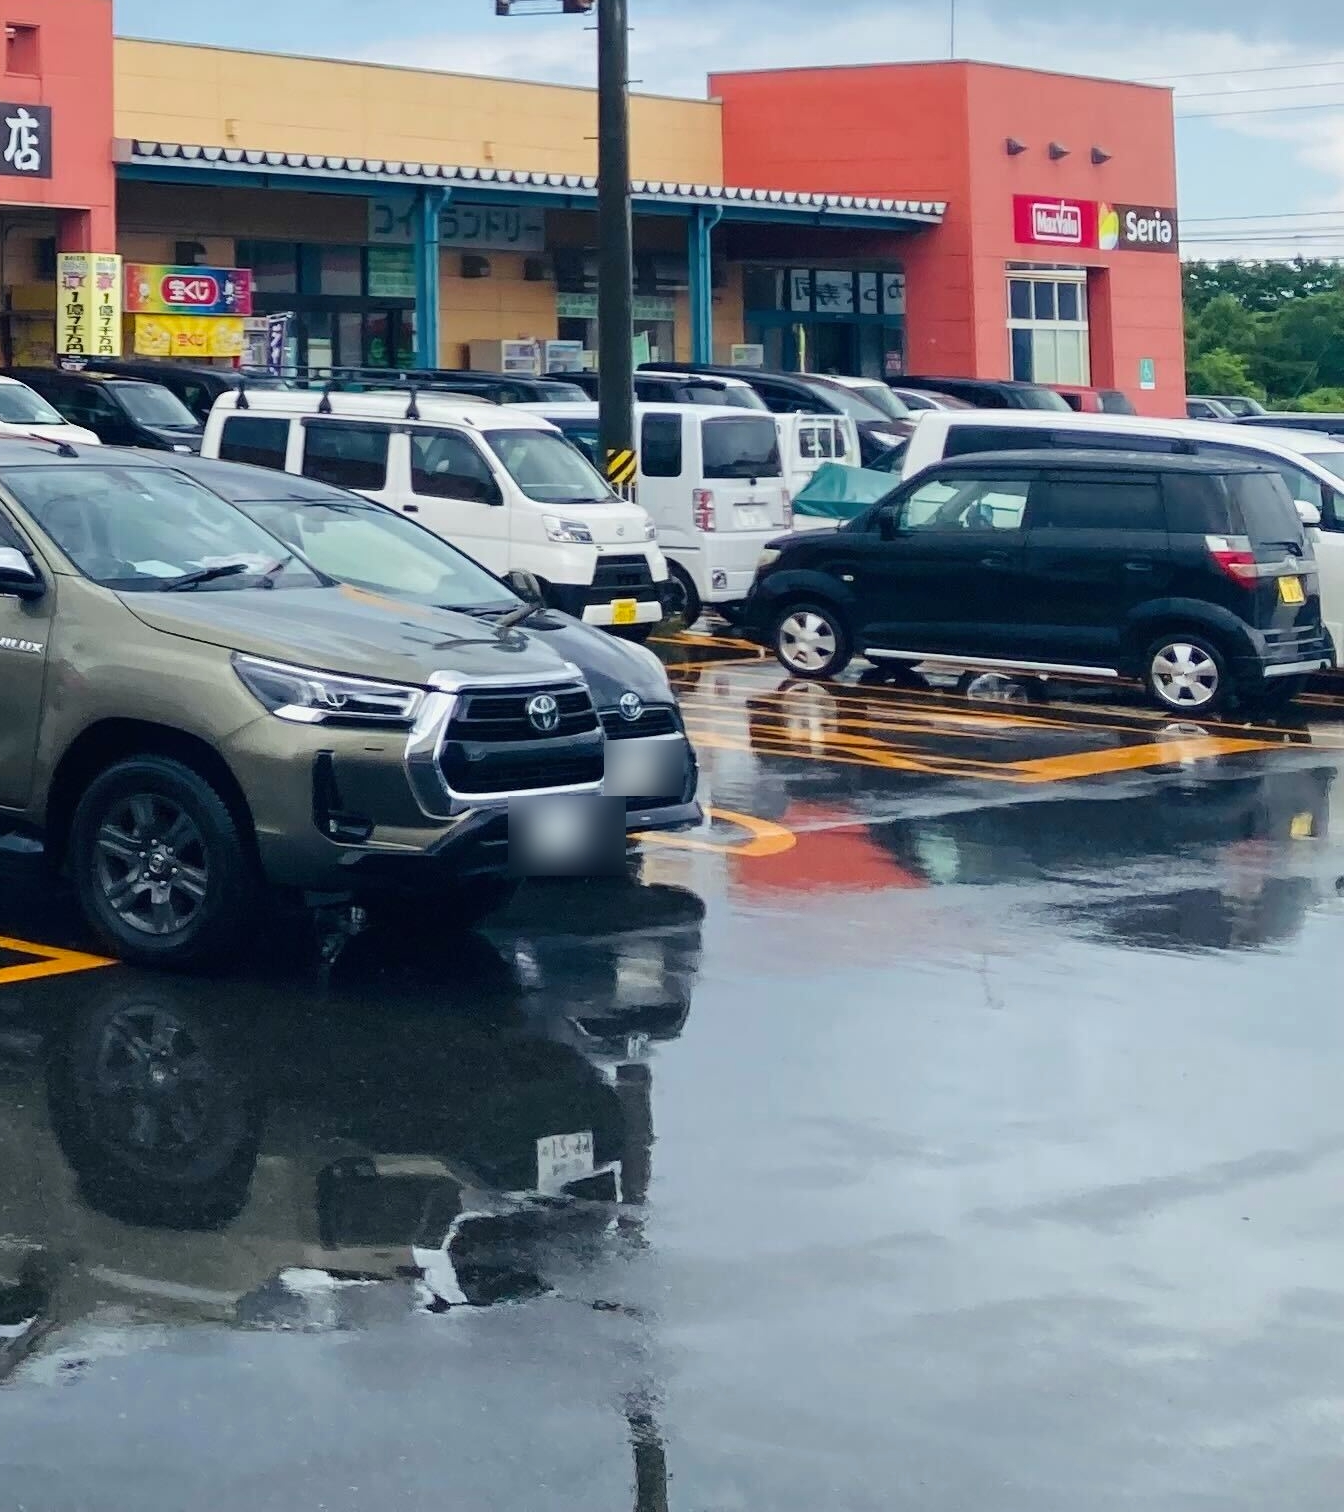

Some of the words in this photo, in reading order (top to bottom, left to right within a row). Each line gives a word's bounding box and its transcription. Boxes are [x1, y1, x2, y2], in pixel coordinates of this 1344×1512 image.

[374, 197, 543, 243] コイランドリー
[1125, 210, 1172, 243] Seria
[168, 279, 210, 301] 宝くじ
